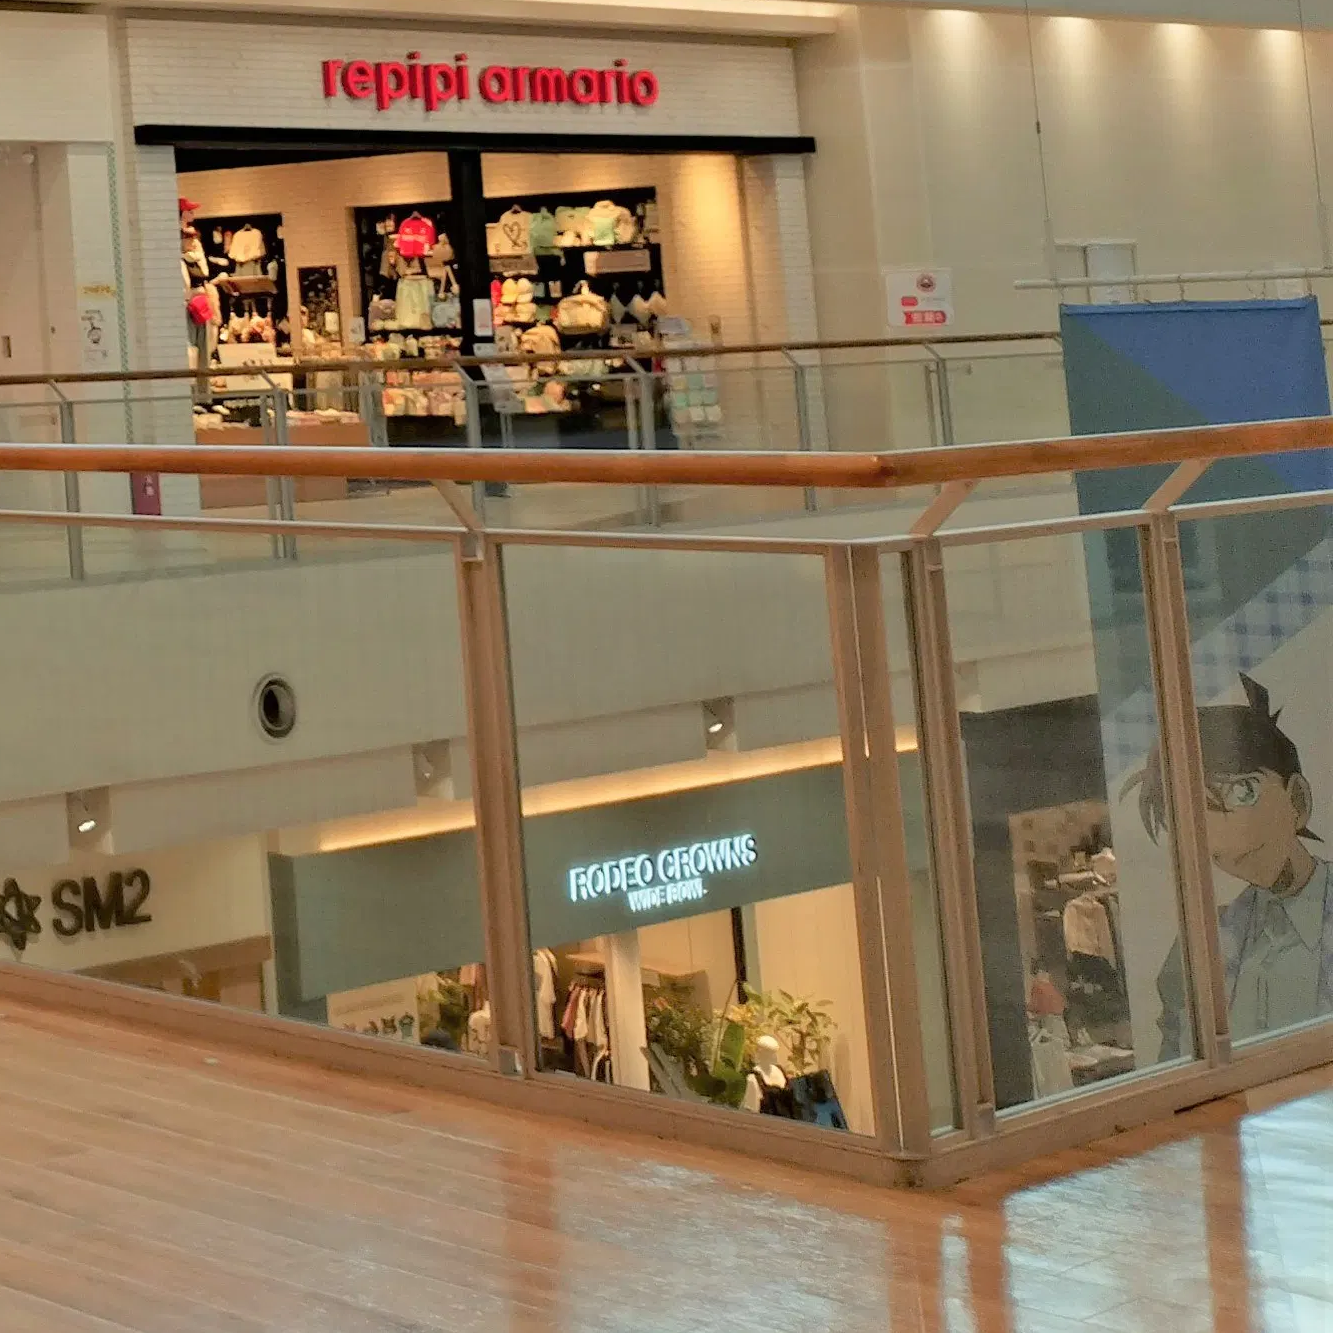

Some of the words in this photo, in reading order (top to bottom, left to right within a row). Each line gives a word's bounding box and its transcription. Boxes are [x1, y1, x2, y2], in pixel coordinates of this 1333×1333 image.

[321, 50, 470, 112] repipi
[478, 58, 659, 107] armario
[568, 854, 655, 903] RODEO
[656, 832, 758, 883] CROWNS
[51, 868, 153, 936] SM2
